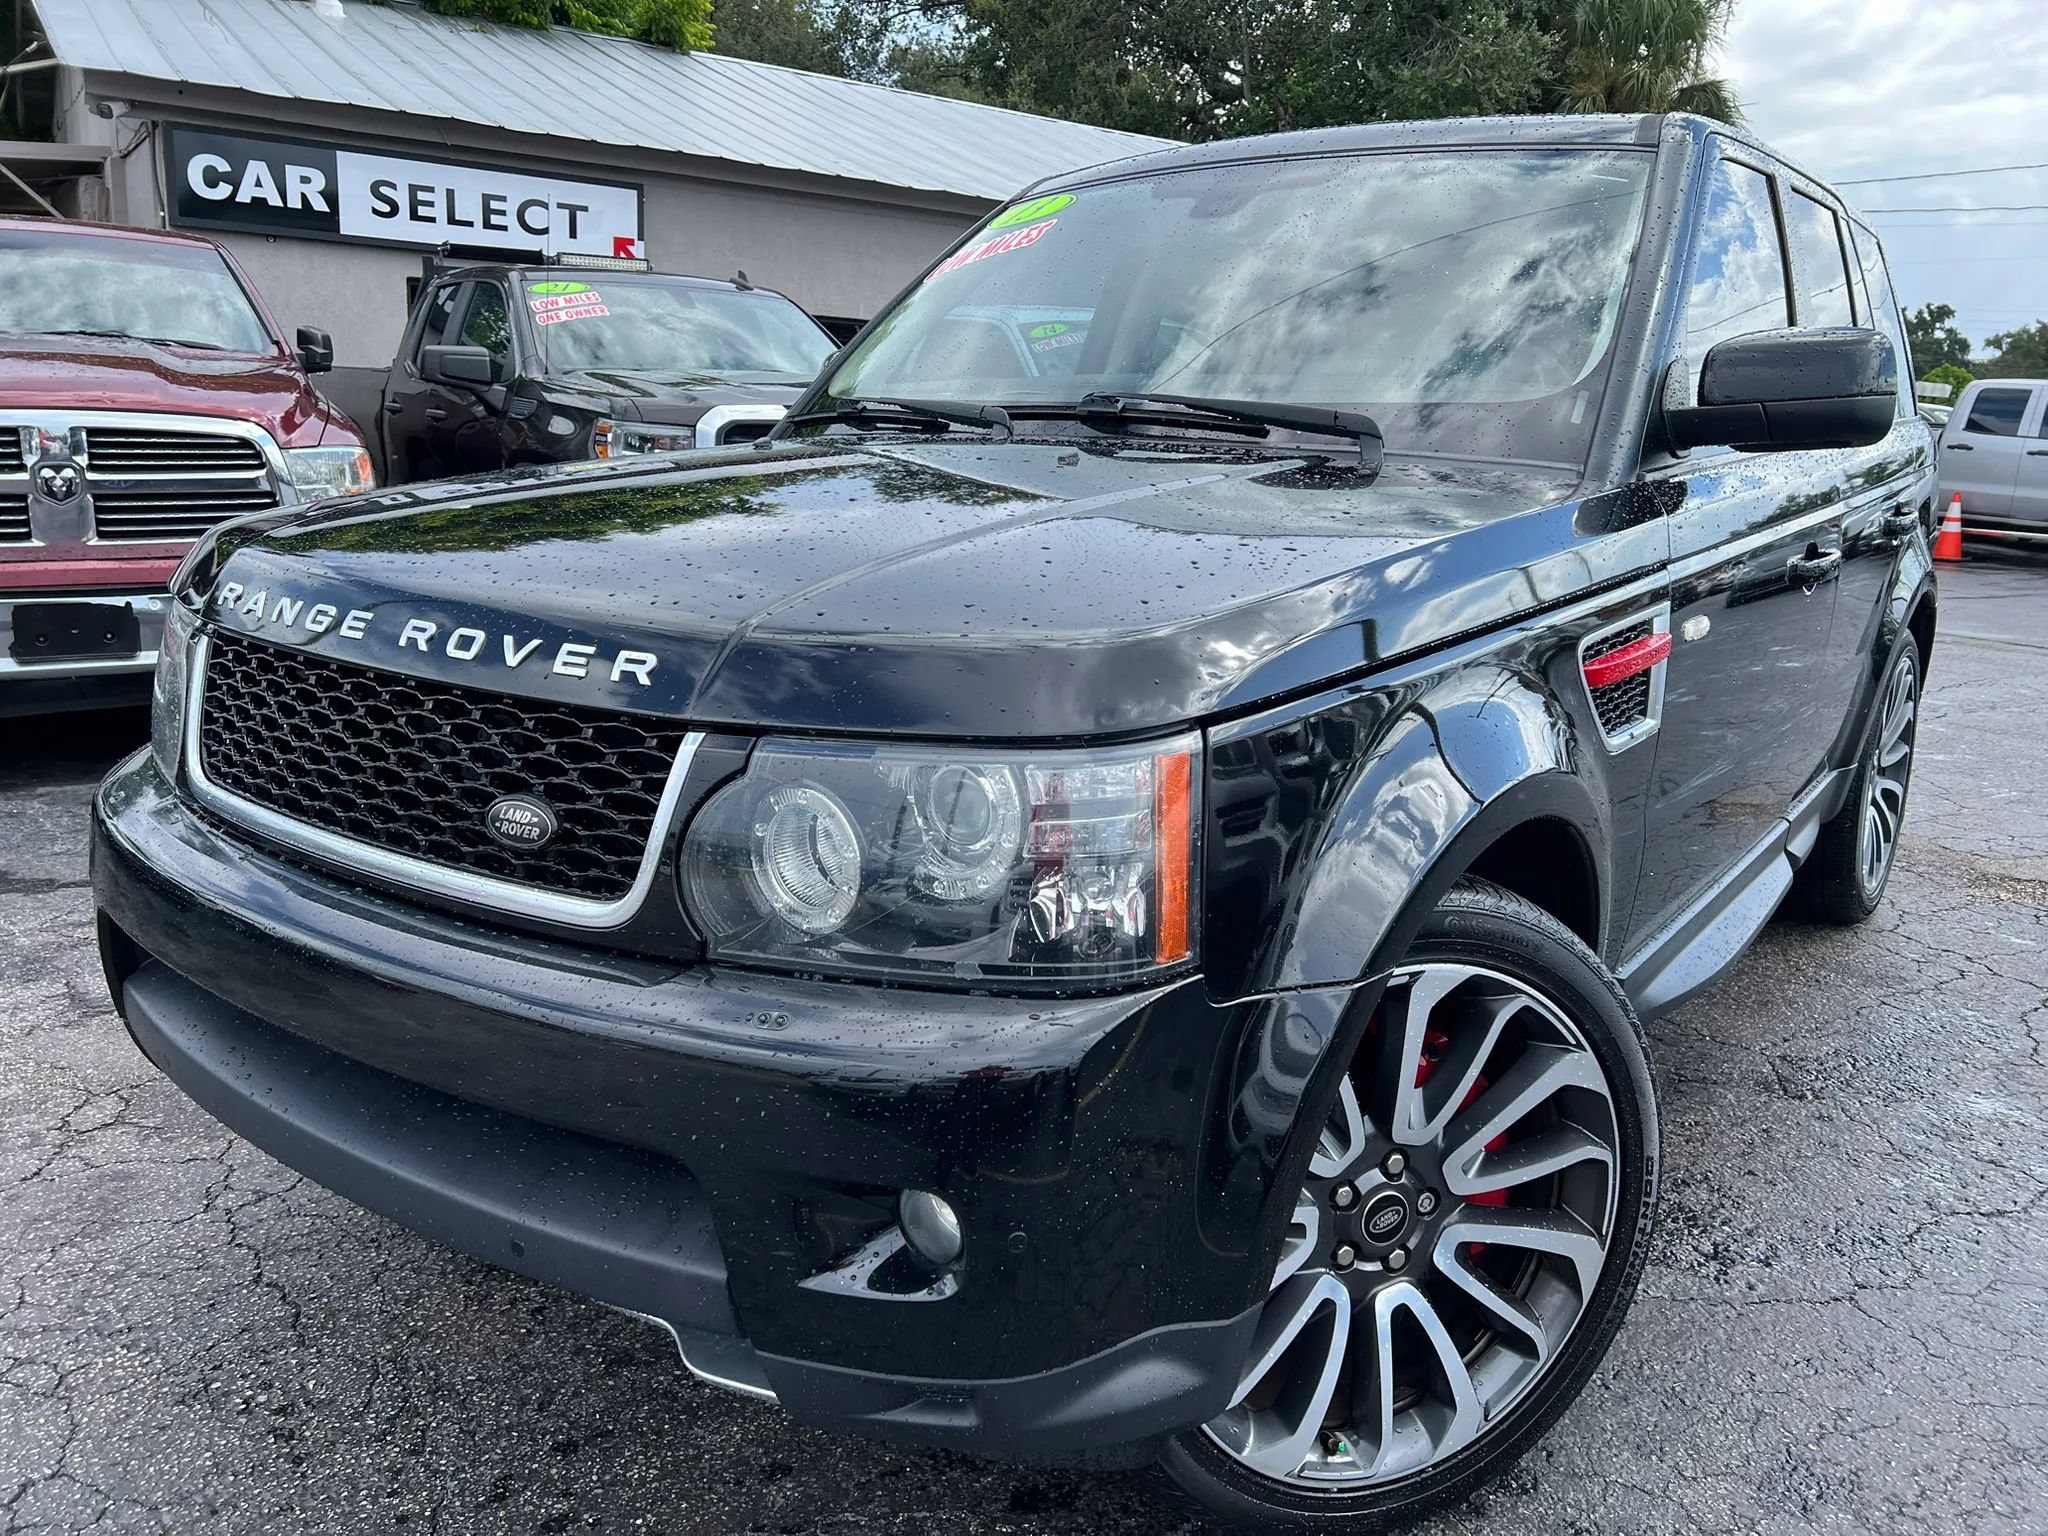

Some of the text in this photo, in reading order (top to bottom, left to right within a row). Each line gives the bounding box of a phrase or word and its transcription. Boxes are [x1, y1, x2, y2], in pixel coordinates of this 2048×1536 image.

[186, 153, 589, 240] CAR SELECT
[975, 219, 1057, 261] MILES
[532, 293, 600, 311] LOW MILES
[538, 306, 606, 324] ONE OWNER
[216, 580, 659, 686] RANGE ROVER
[499, 806, 532, 823] LAND
[500, 820, 540, 840] ROVER
[1376, 1211, 1393, 1225] LAND
[1379, 1214, 1398, 1228] ROVER
